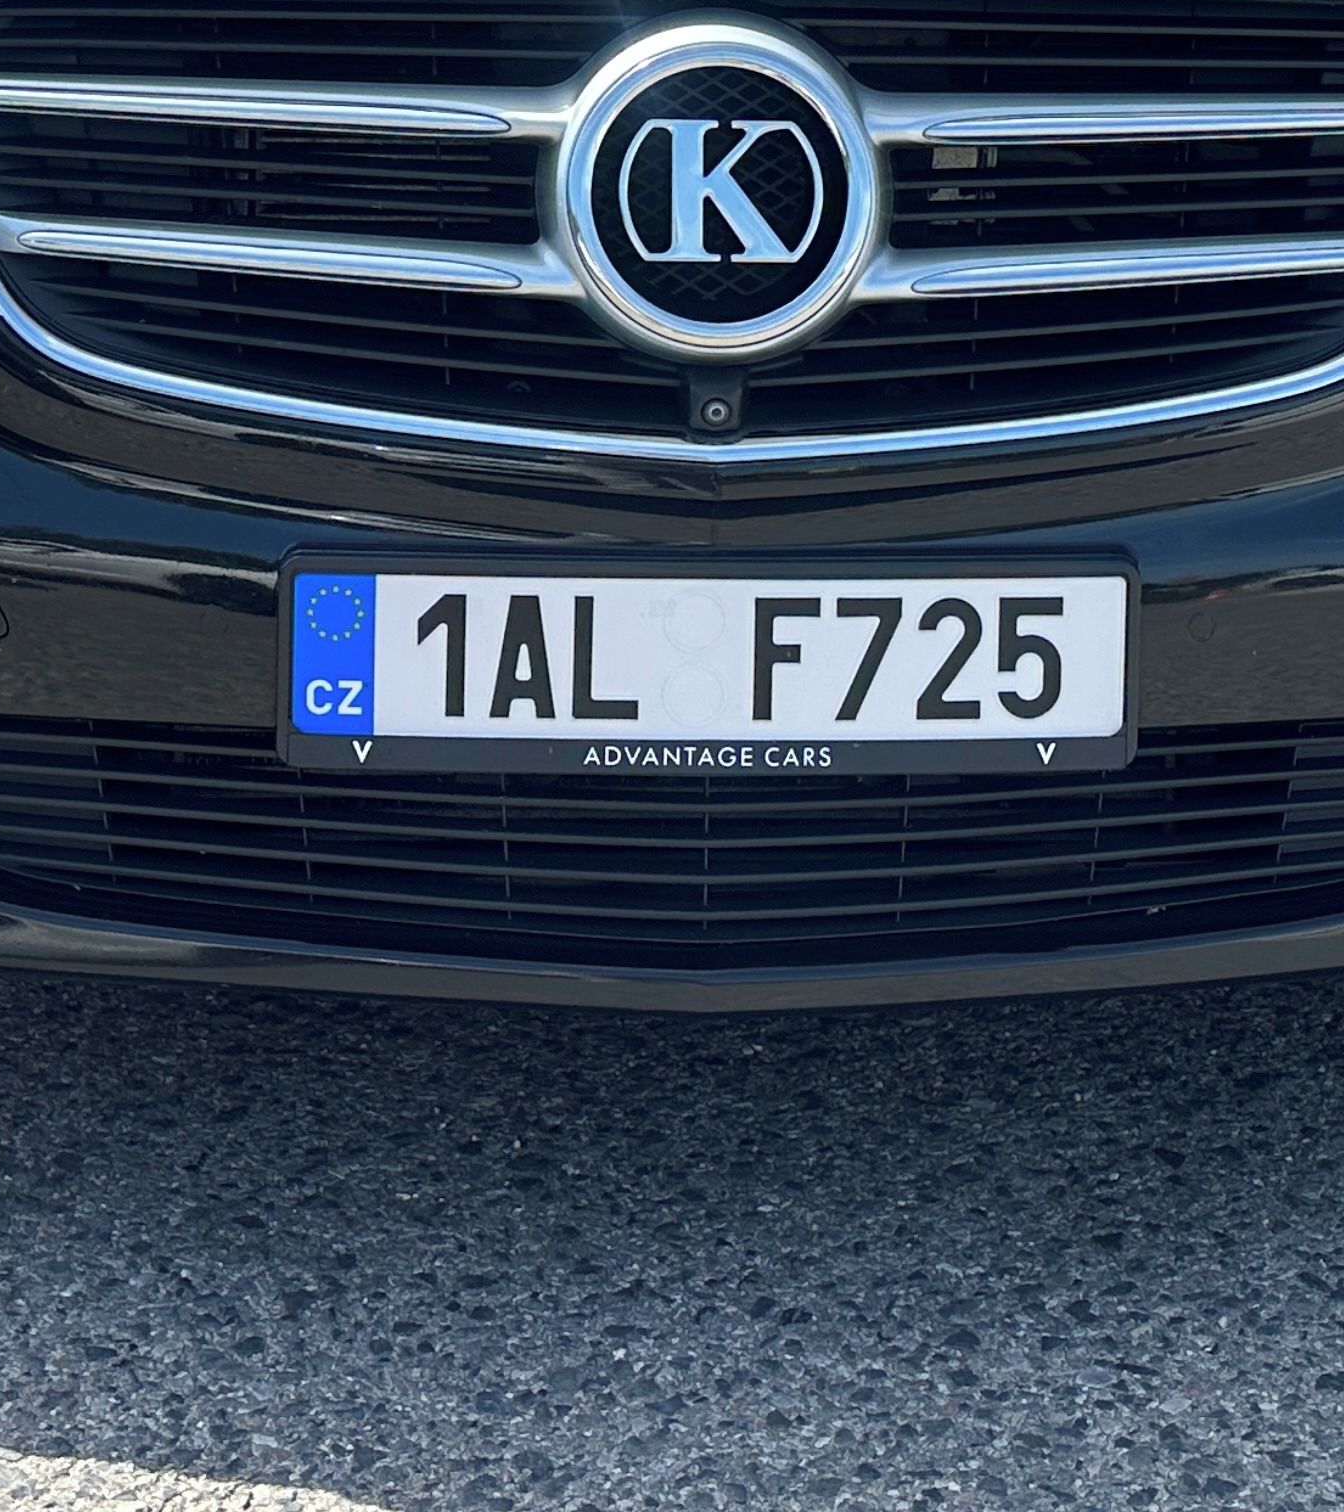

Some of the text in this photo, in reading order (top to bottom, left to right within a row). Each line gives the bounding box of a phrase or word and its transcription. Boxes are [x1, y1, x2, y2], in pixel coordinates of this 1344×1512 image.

[640, 117, 804, 264] K
[304, 680, 364, 717] CZ
[416, 593, 1063, 722] 1AL F725
[584, 745, 833, 769] ADVANTAGE CARS
